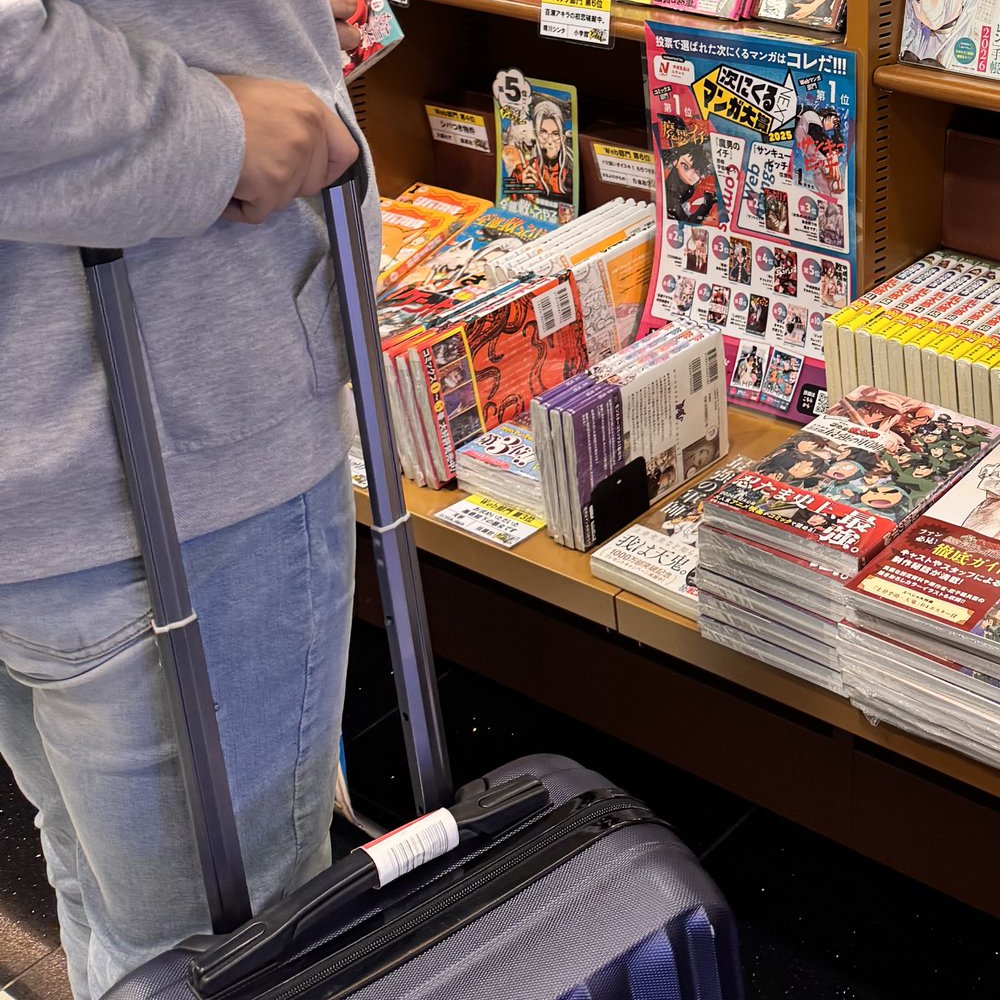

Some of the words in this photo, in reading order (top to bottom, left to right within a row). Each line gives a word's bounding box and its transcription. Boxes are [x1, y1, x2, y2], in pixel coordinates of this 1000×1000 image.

[977, 26, 992, 72] 2026
[663, 94, 693, 118] 第1位
[703, 81, 771, 133] マンガ大賞
[720, 68, 778, 112] 次にくる
[816, 80, 850, 106] 第1位
[768, 130, 793, 142] 2025
